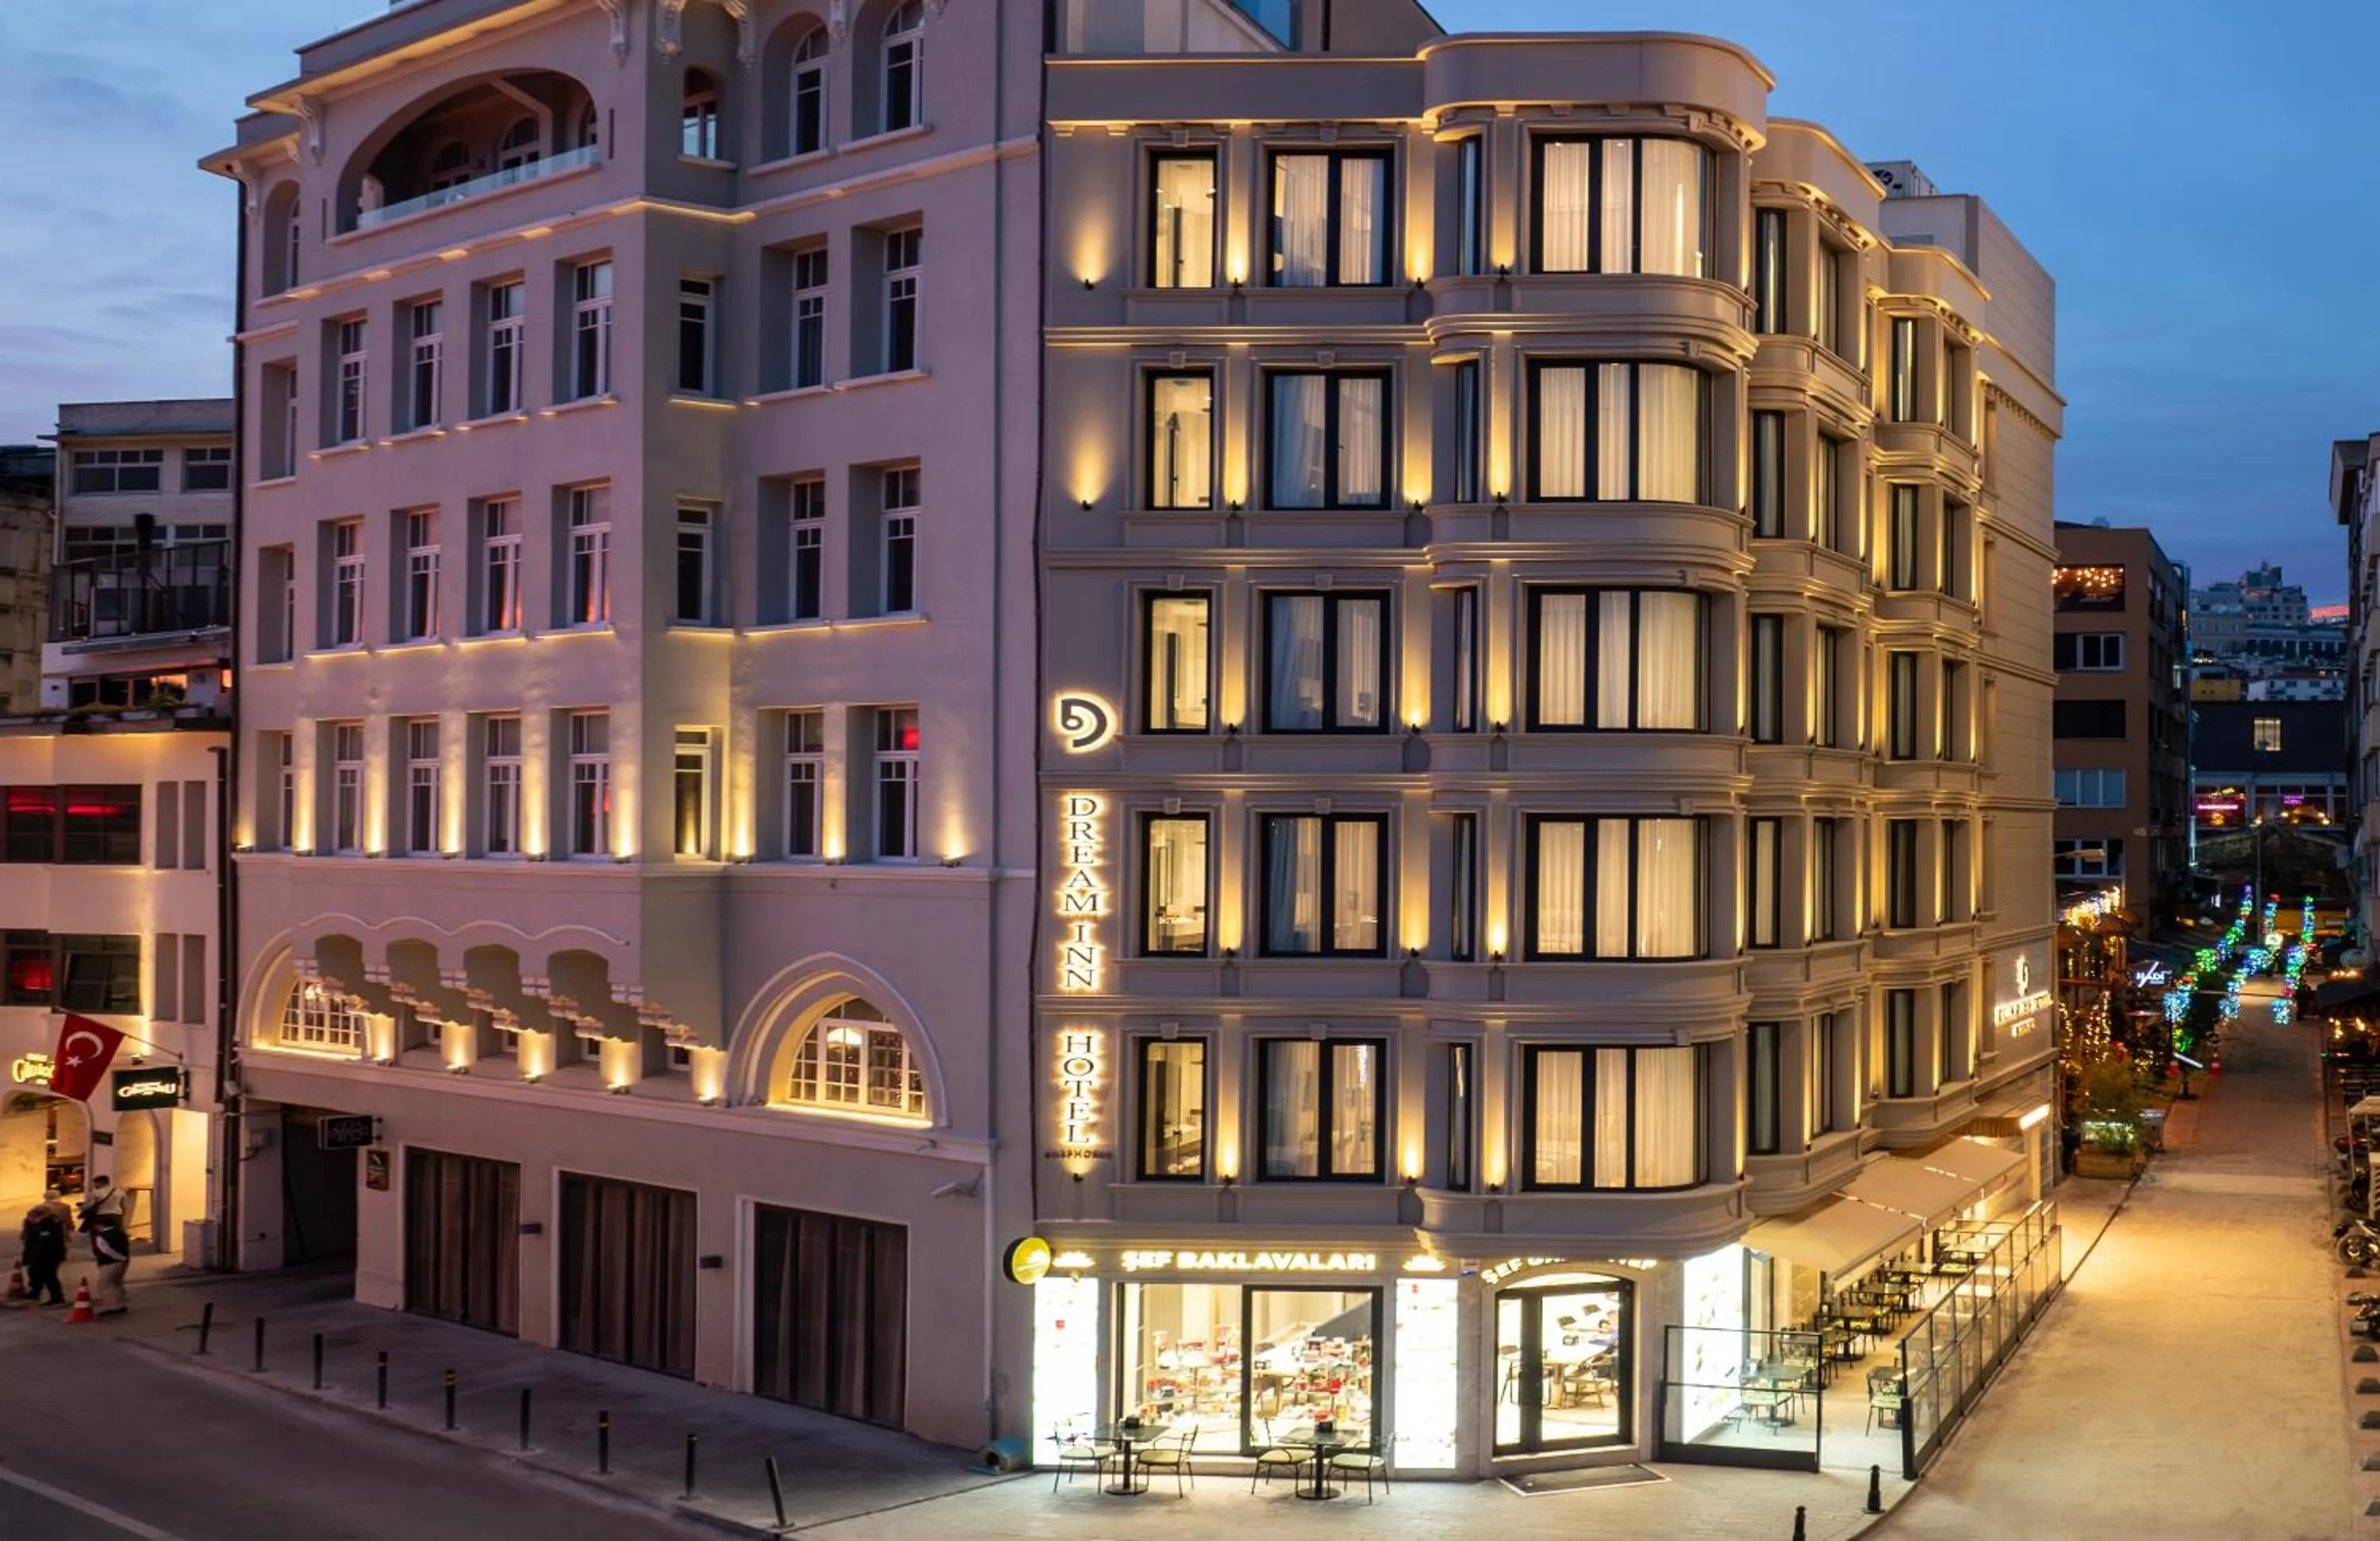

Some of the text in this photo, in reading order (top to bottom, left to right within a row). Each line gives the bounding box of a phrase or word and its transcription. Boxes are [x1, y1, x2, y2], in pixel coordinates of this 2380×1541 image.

[1064, 797, 1098, 987] DREAM INN
[1063, 1035, 1094, 1143] HOTEL
